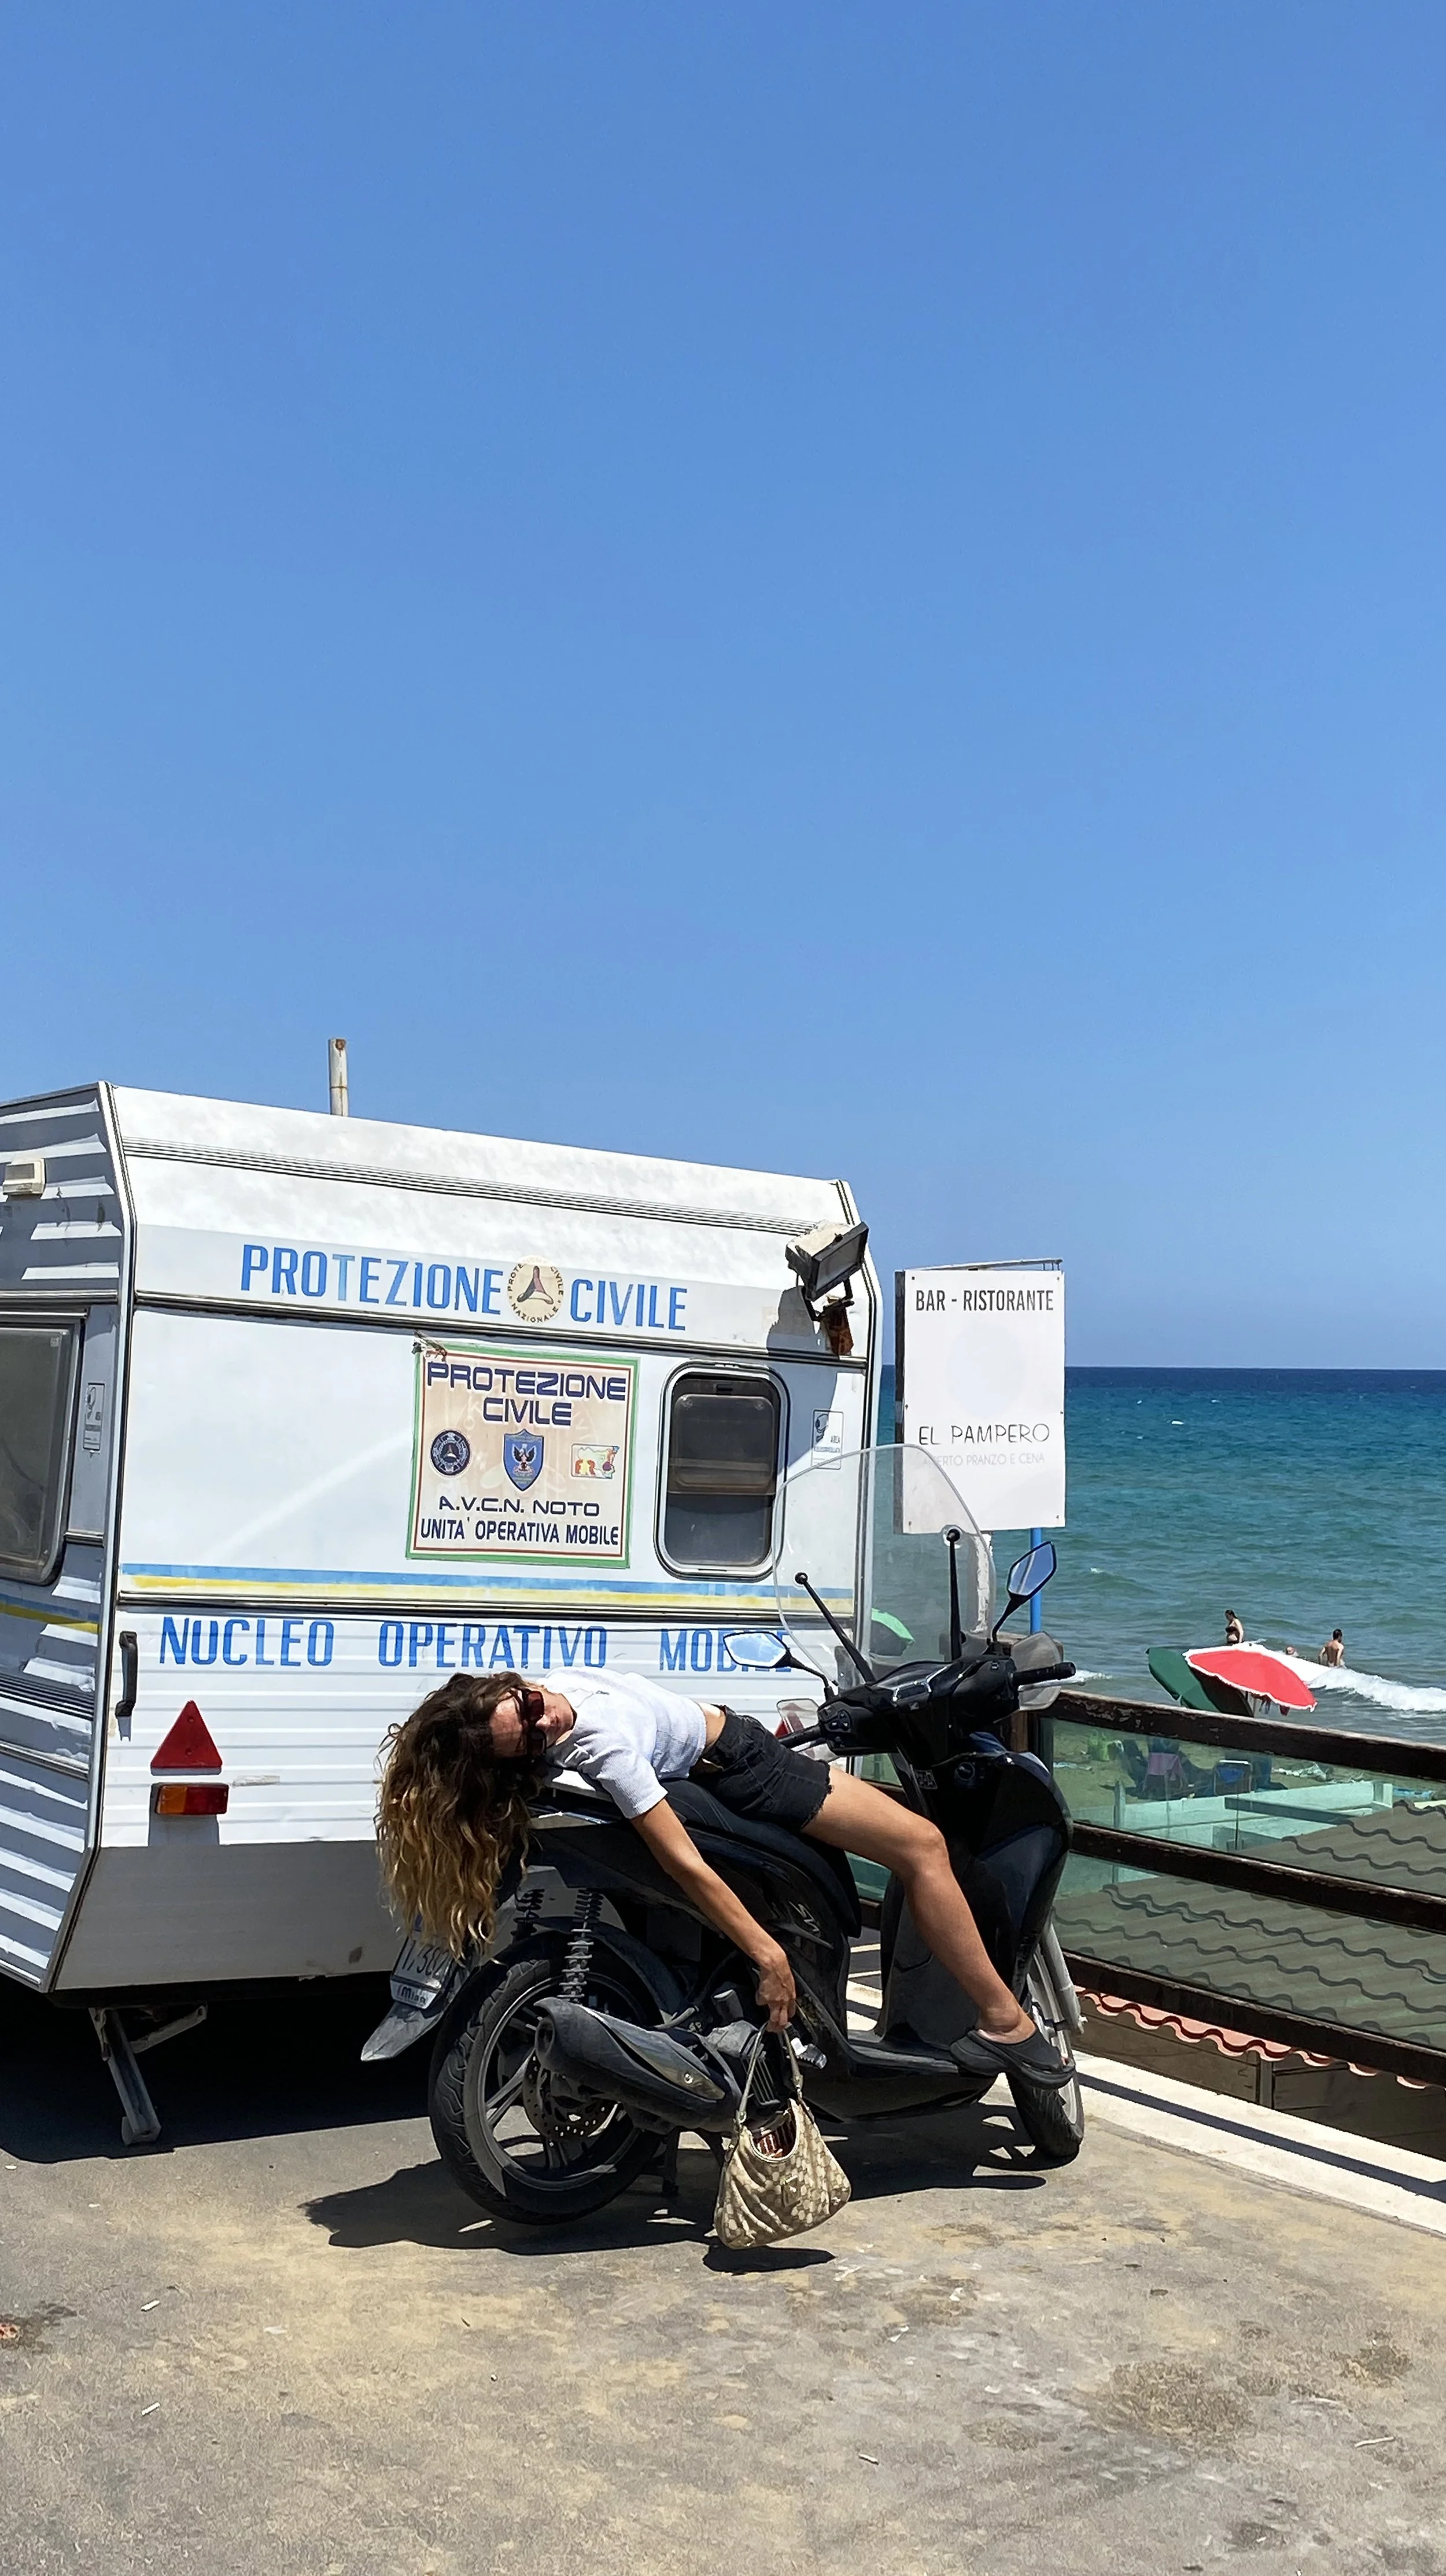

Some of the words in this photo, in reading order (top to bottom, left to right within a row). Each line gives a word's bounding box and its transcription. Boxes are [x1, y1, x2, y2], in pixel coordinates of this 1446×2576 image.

[241, 1244, 504, 1315] PROTEZIONE
[570, 1279, 688, 1330] CIVILE
[916, 1290, 945, 1311] BAR
[964, 1290, 1054, 1311] RISTORANTE
[511, 1303, 559, 1323] NAZIONALE
[427, 1362, 626, 1401] PROTEZIONE
[484, 1398, 572, 1426] CIVILE
[919, 1427, 940, 1445] EL
[951, 1424, 1049, 1443] PAMPERO
[967, 1453, 1006, 1465] PRANZO
[1010, 1453, 1015, 1464] E
[1019, 1452, 1045, 1464] CENA
[438, 1495, 525, 1513] A.V.C.N.
[533, 1500, 600, 1517] NOTO
[475, 1520, 559, 1543] OPERATIVA
[566, 1525, 619, 1546] MOBILE
[160, 1616, 334, 1667] NUCLEO
[379, 1621, 607, 1670] OPERATIVO
